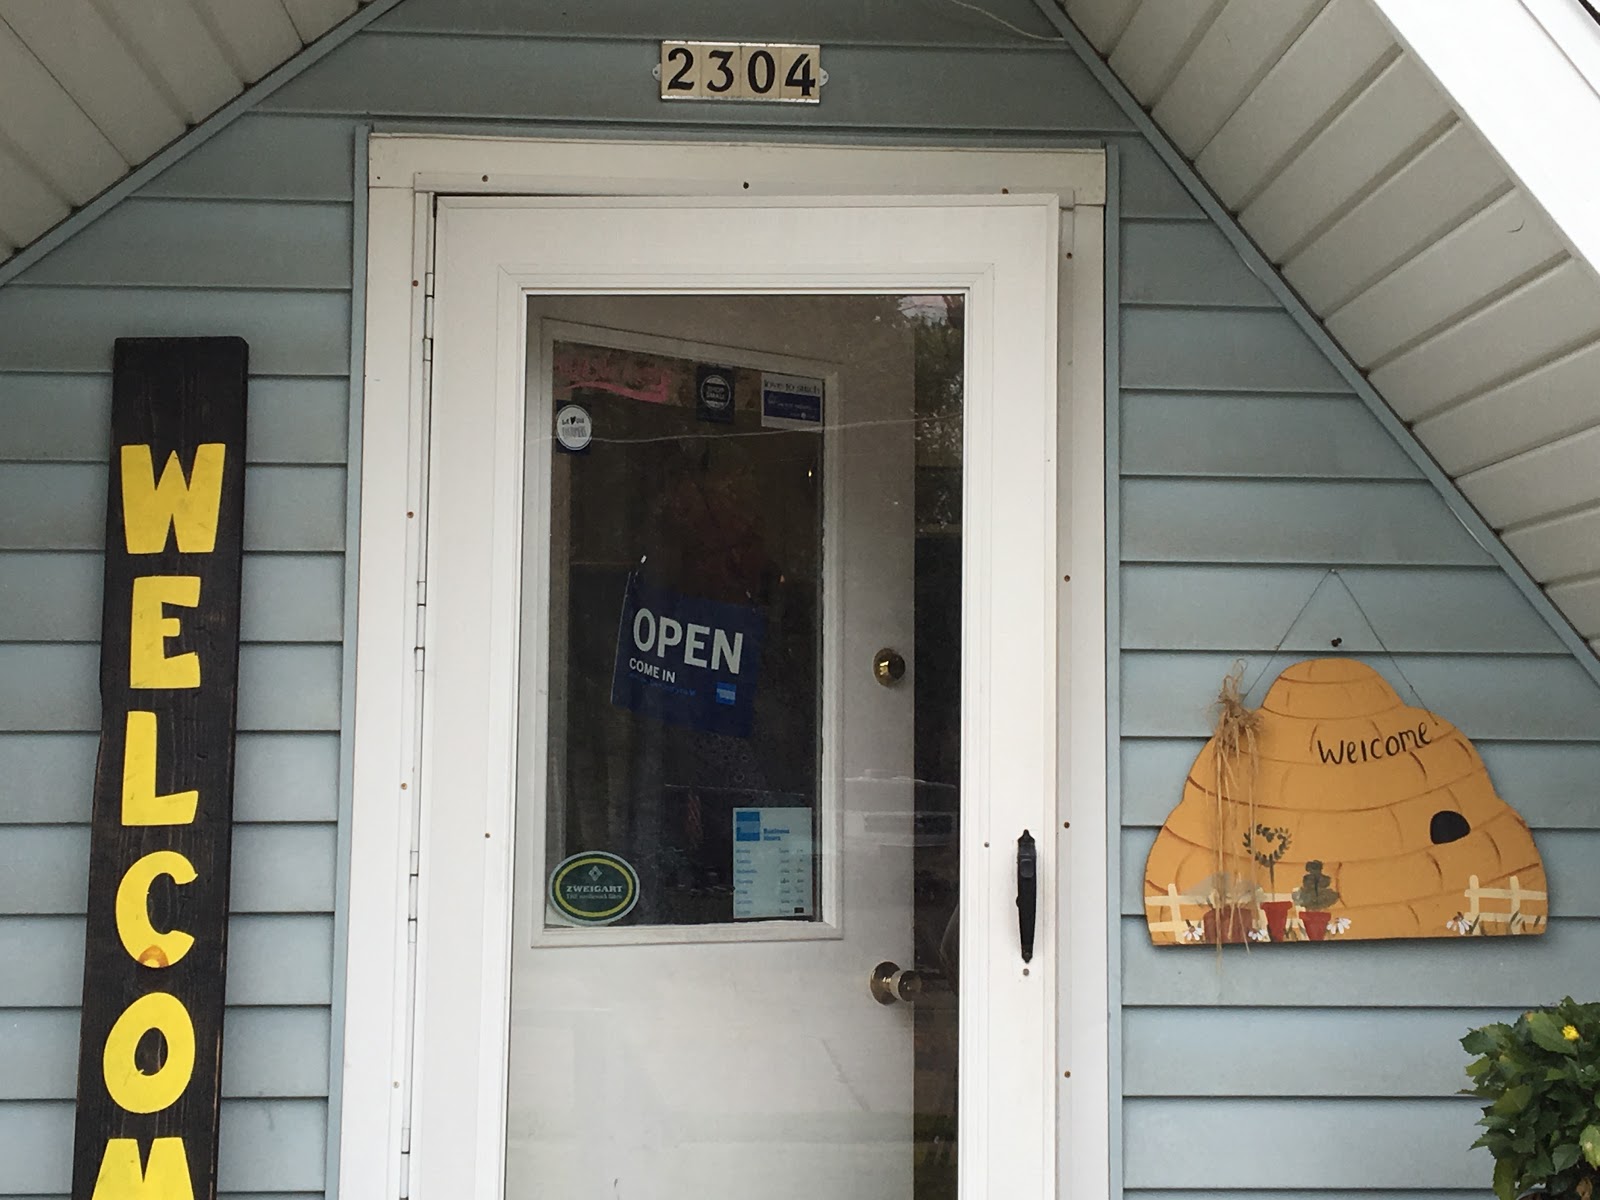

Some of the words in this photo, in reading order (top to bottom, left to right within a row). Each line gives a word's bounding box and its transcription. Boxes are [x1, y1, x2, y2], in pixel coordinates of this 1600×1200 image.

[668, 47, 816, 97] 2304
[633, 607, 743, 674] OPEN
[629, 658, 660, 679] COME
[662, 669, 676, 684] IN
[1317, 722, 1432, 765] Welcome
[566, 885, 623, 893] ZWEIGART
